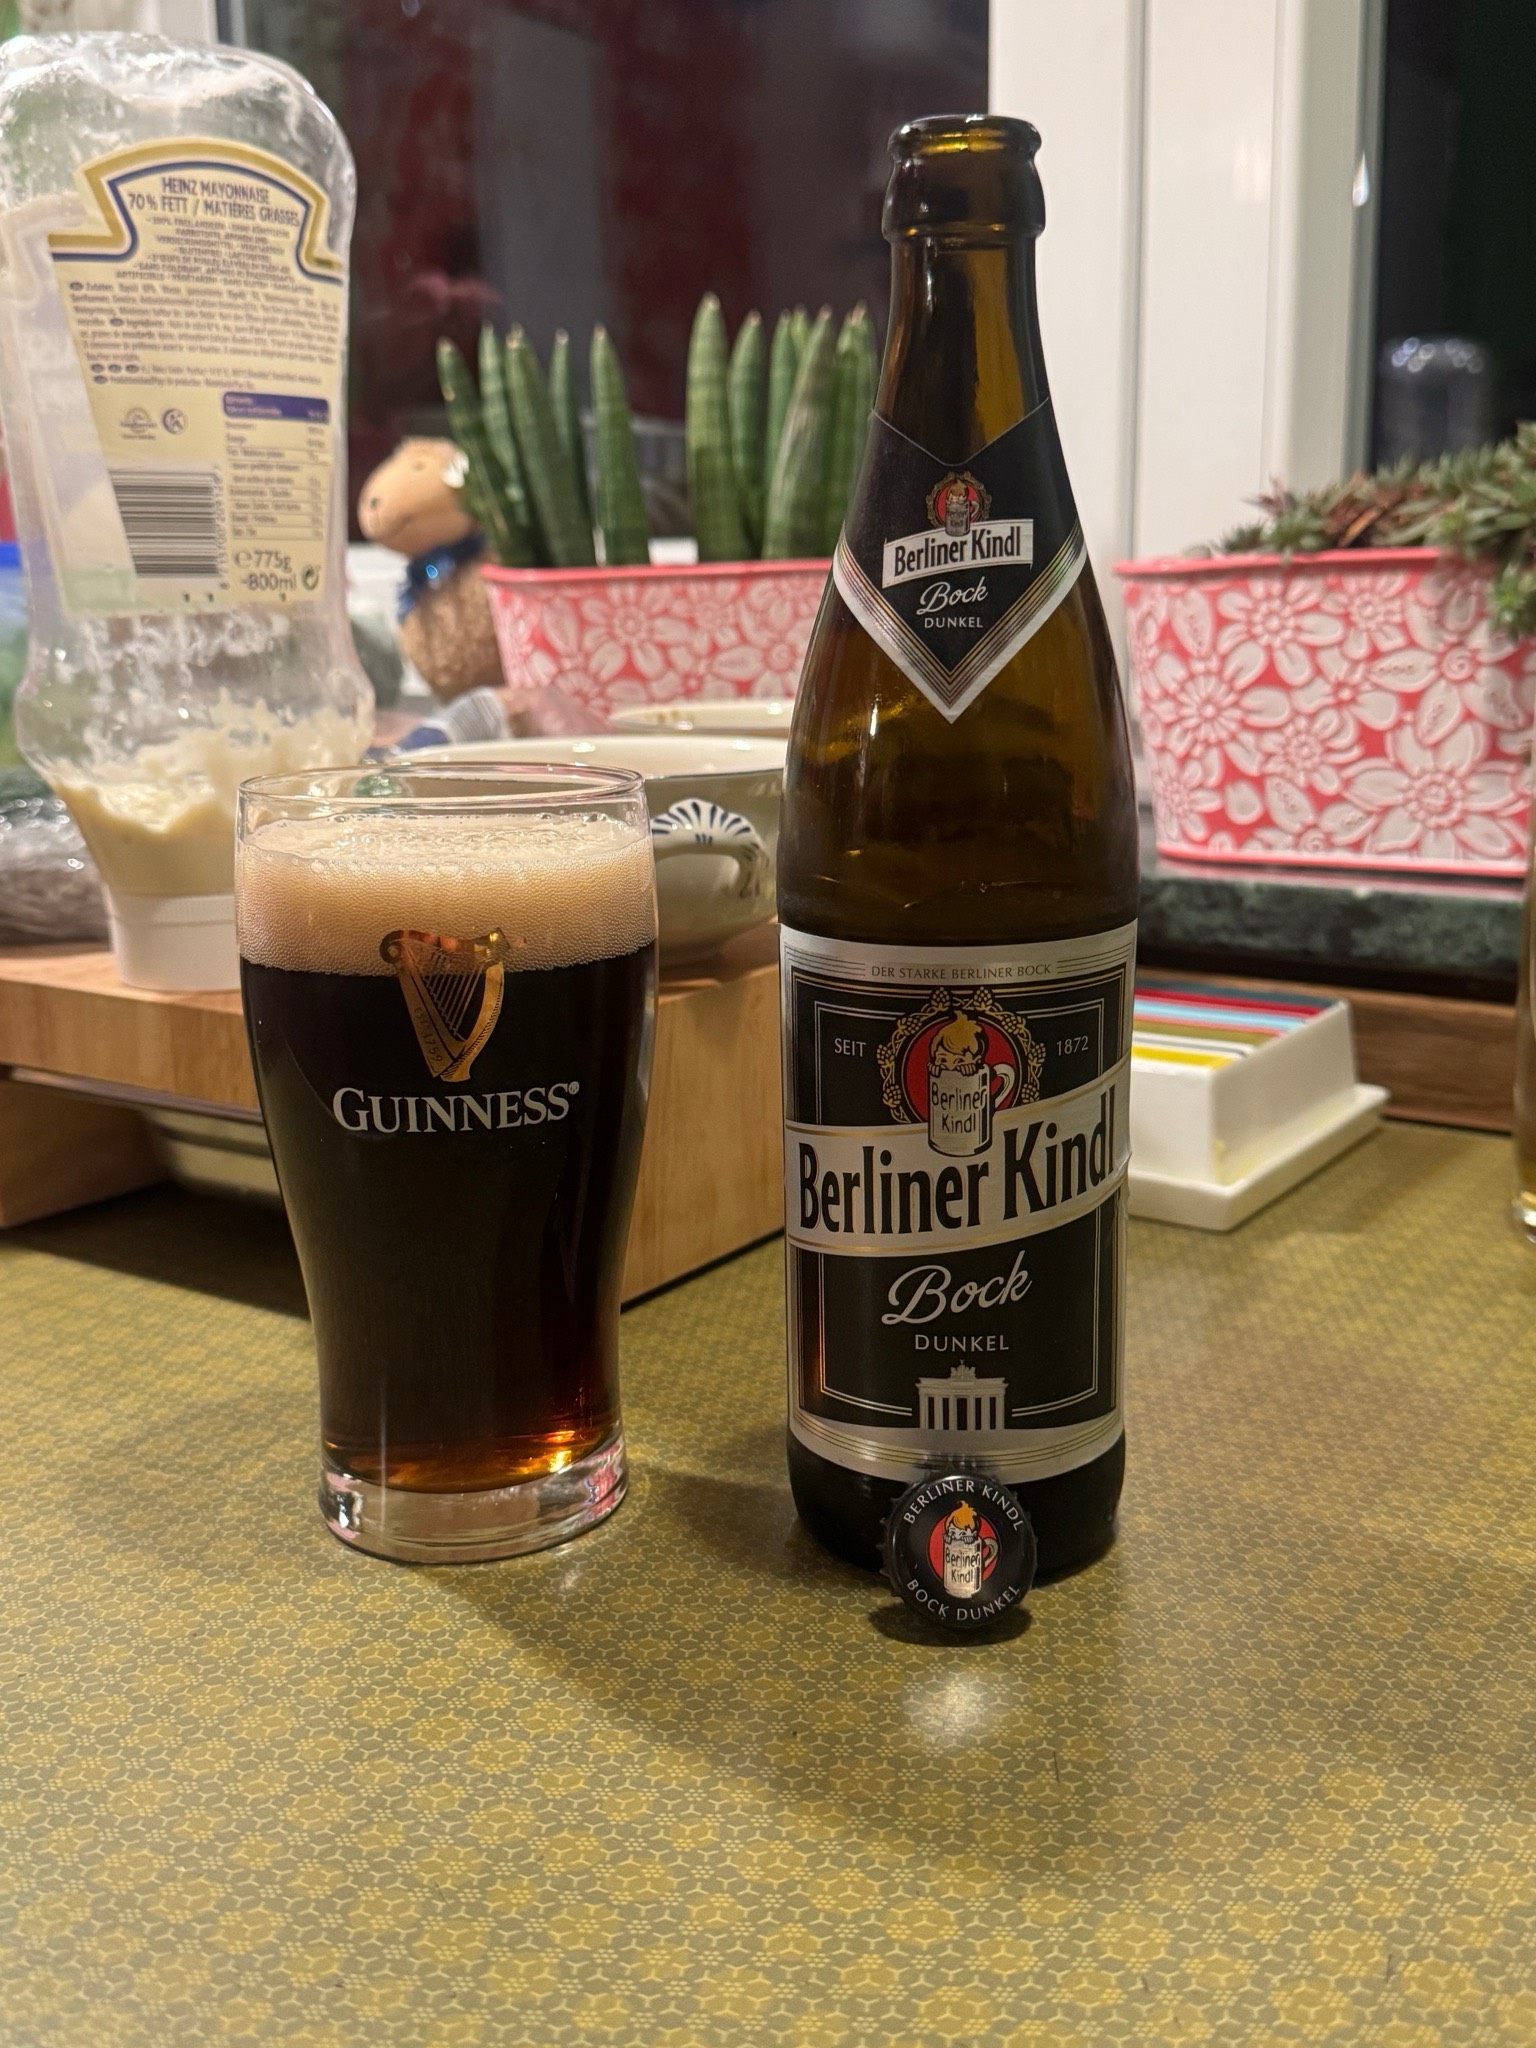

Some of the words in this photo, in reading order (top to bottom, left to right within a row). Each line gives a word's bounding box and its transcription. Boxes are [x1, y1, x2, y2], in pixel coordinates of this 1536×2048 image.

[162, 177, 197, 196] HEINZ
[200, 182, 269, 205] MAYONNAISE
[161, 196, 188, 214] FETT
[894, 538, 967, 576] Berliner
[971, 526, 1021, 561] Kindl
[916, 576, 988, 616] Bock
[924, 617, 983, 628] DUNKEL
[871, 965, 895, 978] DER
[899, 966, 947, 980] STARKE
[951, 966, 1013, 980] BERLINER
[1017, 964, 1051, 977] BOCK
[834, 1037, 867, 1058] SEIT
[1055, 1036, 1090, 1056] 1872
[931, 1081, 987, 1112] Berliner
[941, 1112, 977, 1134] Kindl
[798, 1141, 990, 1235] Berliner
[1002, 1083, 1117, 1221] Kindl
[881, 1250, 1033, 1325] Bock
[914, 1334, 1009, 1352] DUNKEL
[903, 1479, 975, 1525] BERLINER
[981, 1484, 1025, 1532] KINDL
[945, 1547, 981, 1569] Berliner
[951, 1569, 974, 1584] Kindl
[906, 1578, 950, 1618] BOCK
[956, 1585, 1021, 1622] DUNKEL
